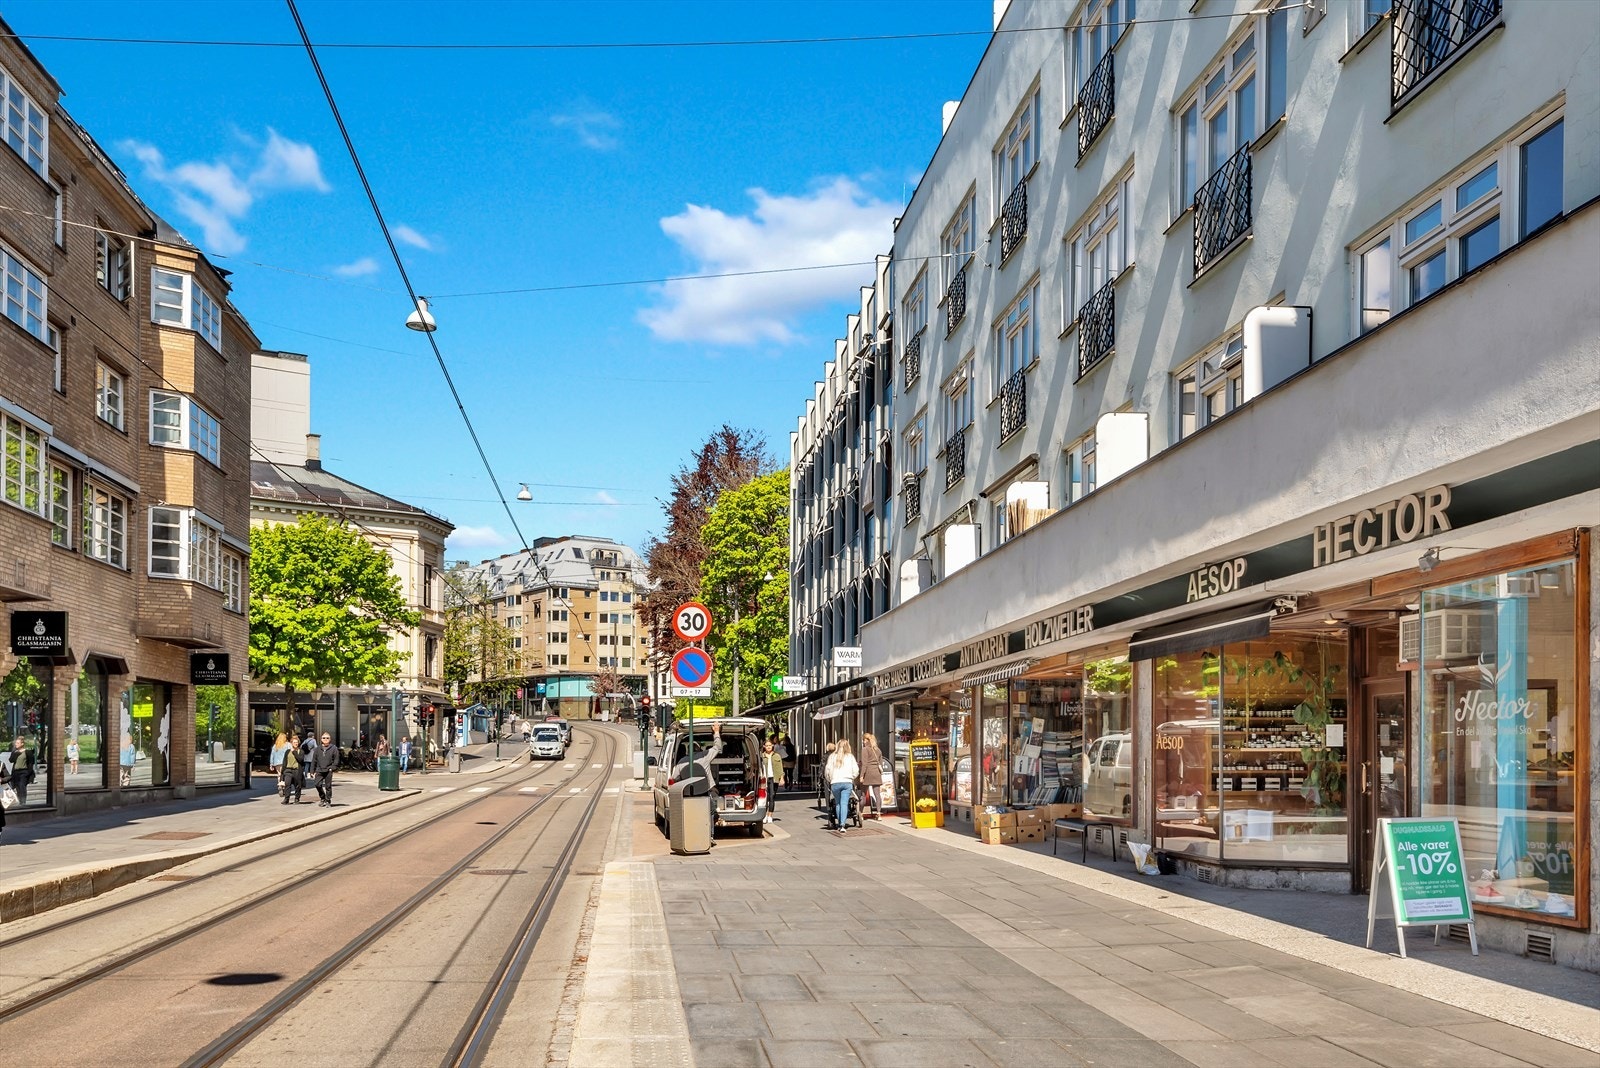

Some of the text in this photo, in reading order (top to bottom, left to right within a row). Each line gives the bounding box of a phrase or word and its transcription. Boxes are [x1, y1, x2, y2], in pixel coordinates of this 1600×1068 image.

[1313, 484, 1451, 568] HECTOR
[680, 612, 705, 631] 30
[1024, 605, 1094, 650] HOLZWEILER
[960, 632, 1009, 668] ANTIKVARIAT
[891, 665, 910, 688] HANSEN
[913, 654, 946, 681] L'OCCITANE
[1455, 690, 1534, 722] Hector
[1456, 727, 1464, 736] En
[1465, 726, 1475, 736] del
[1398, 841, 1450, 851] Alle varer
[1397, 851, 1457, 875] -10%
